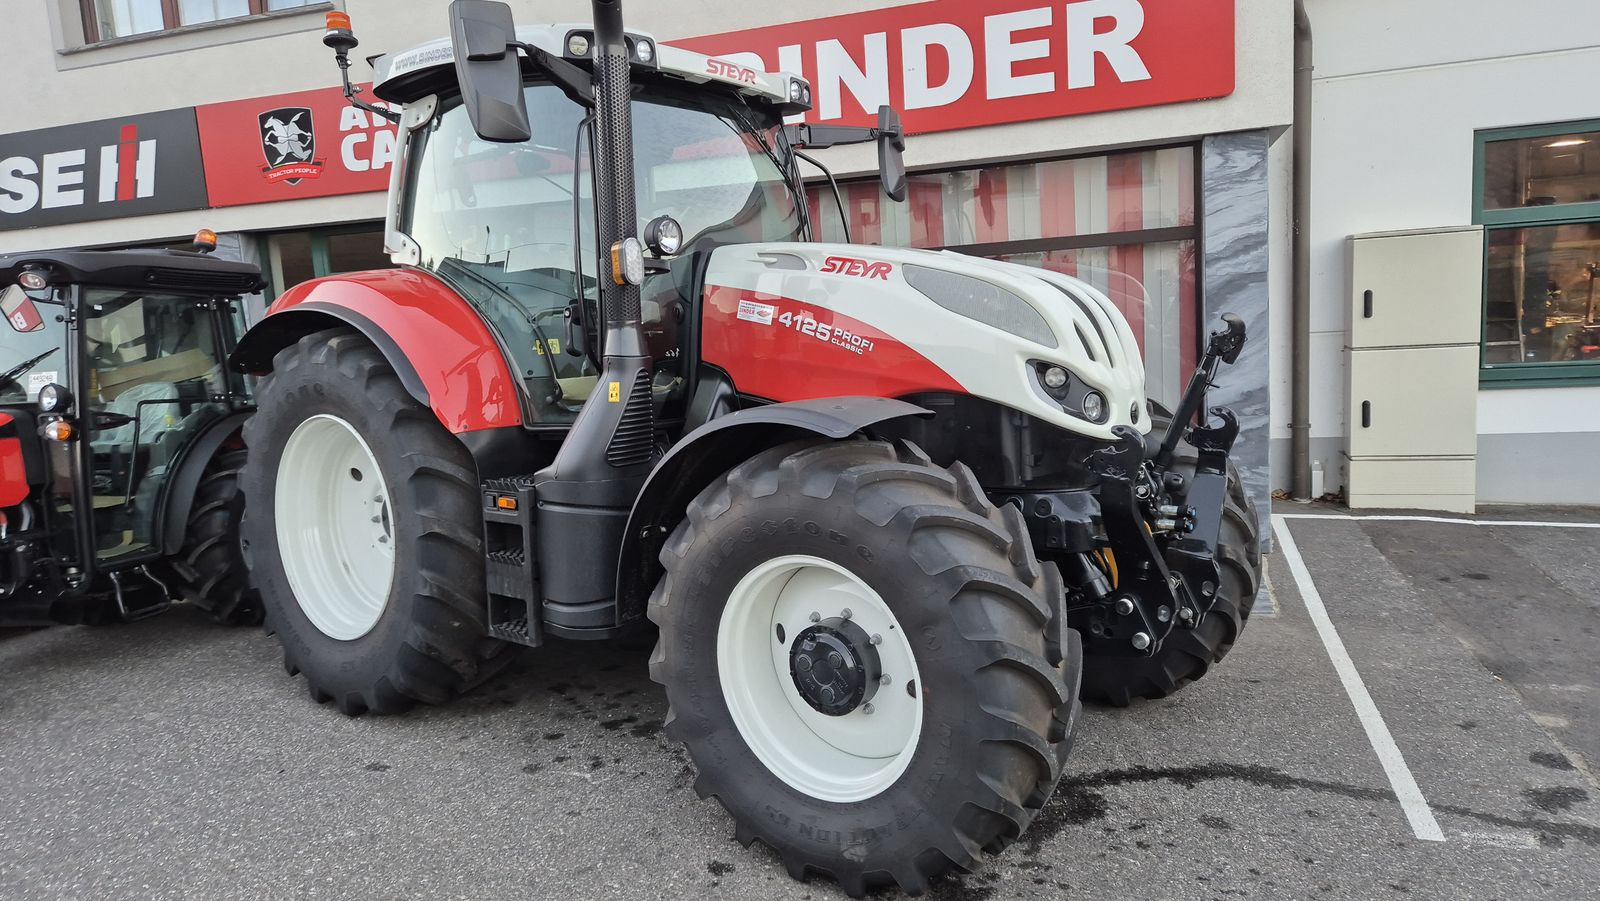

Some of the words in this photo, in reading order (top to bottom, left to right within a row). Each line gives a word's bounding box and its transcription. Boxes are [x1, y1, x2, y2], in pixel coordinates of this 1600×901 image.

[706, 59, 756, 84] STEYR
[268, 168, 294, 179] TRACTOR
[294, 167, 318, 175] PEOPLE
[819, 256, 893, 281] STEYR
[778, 311, 832, 342] 4125
[833, 328, 874, 352] PROFI
[831, 337, 864, 355] CLASSIC
